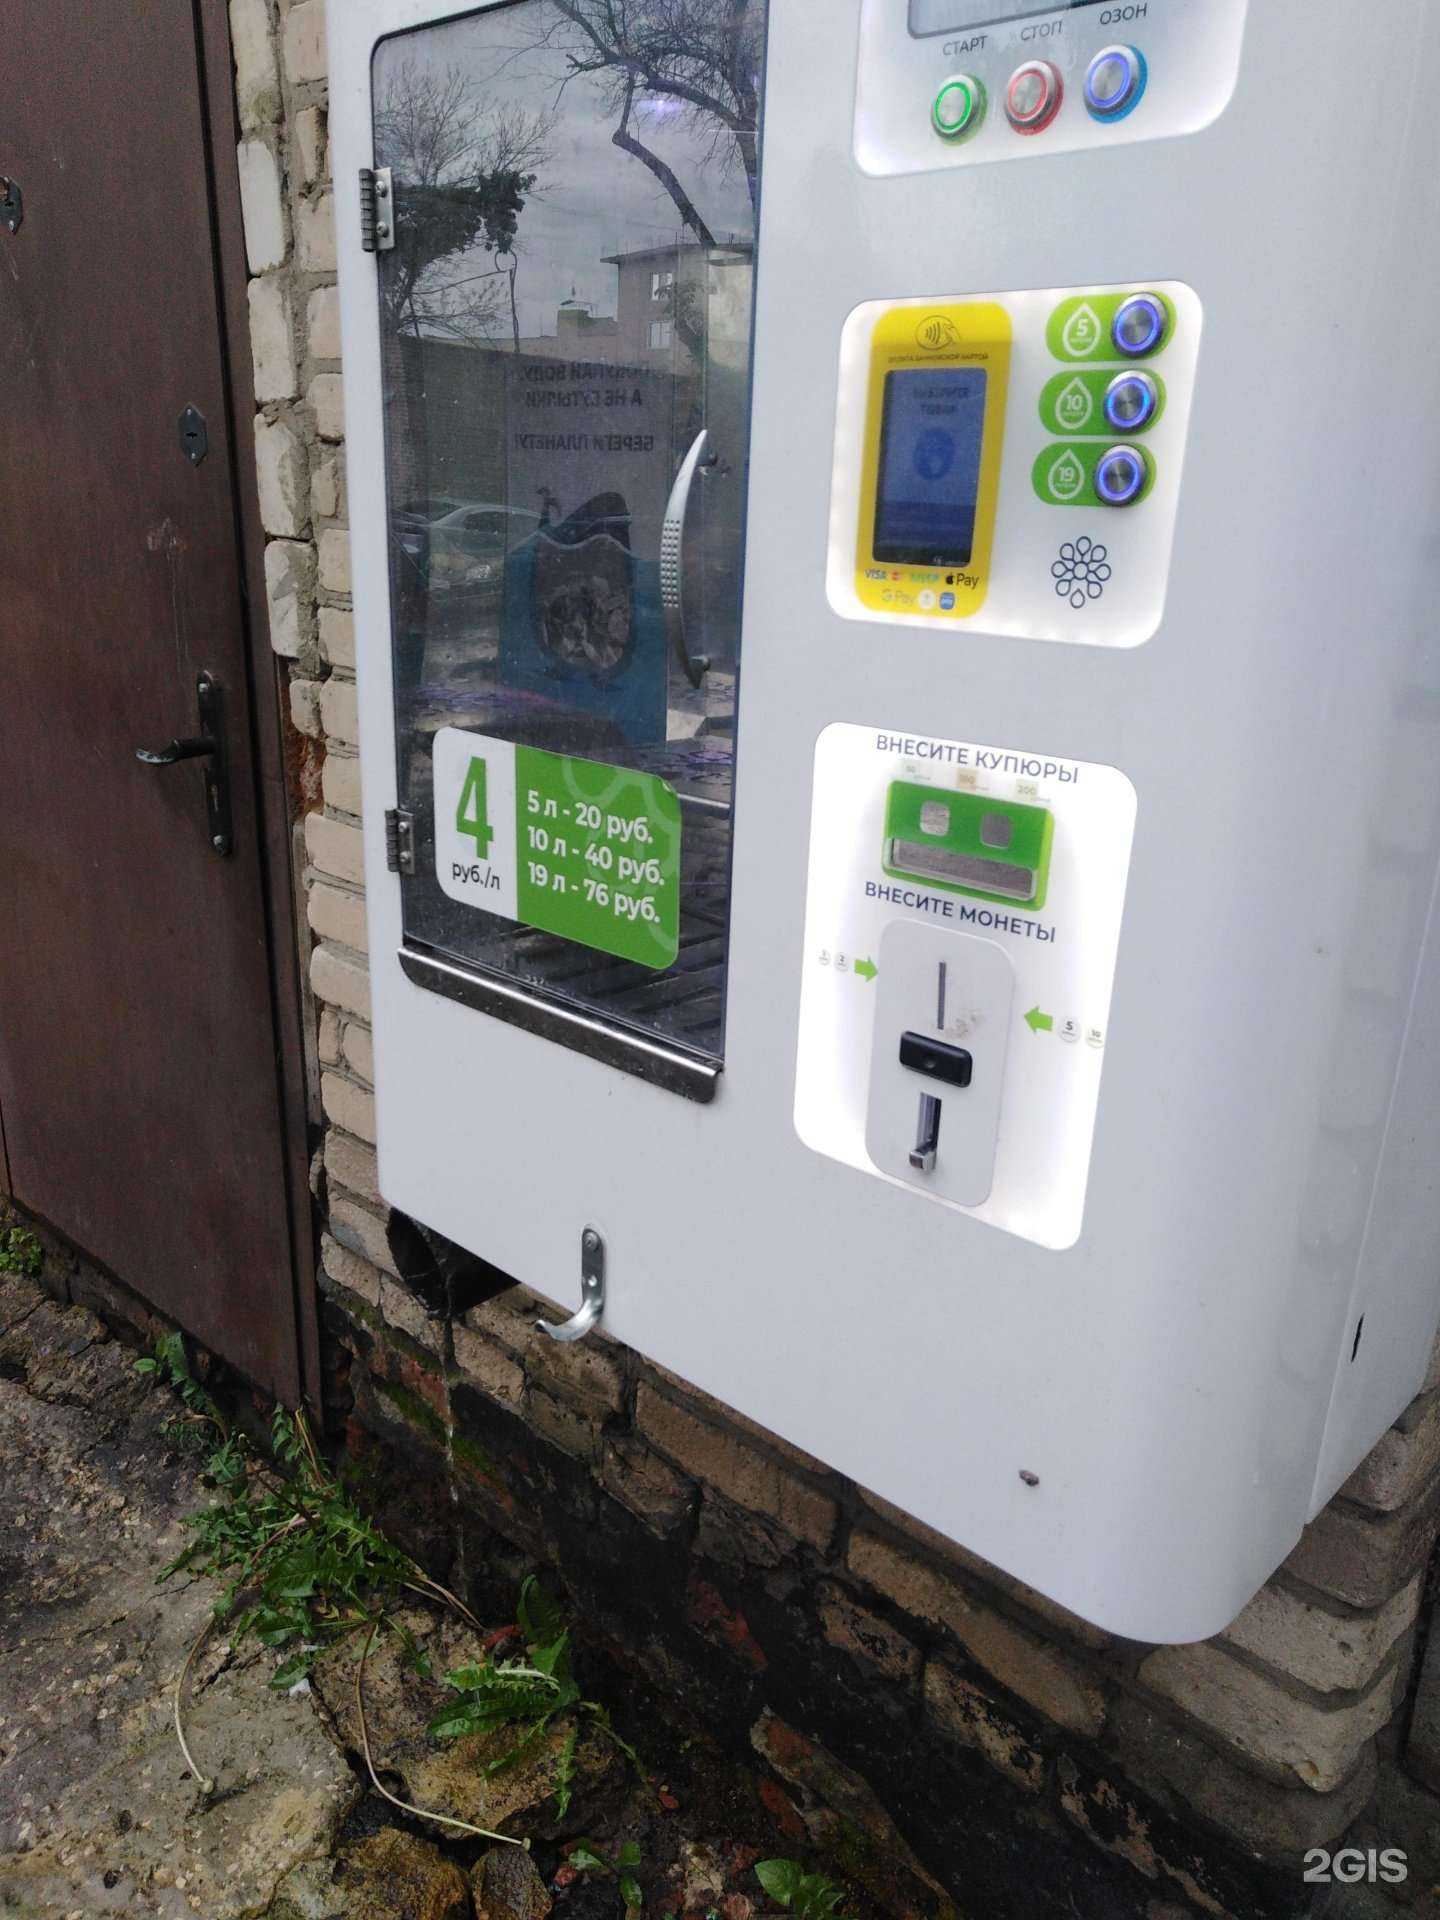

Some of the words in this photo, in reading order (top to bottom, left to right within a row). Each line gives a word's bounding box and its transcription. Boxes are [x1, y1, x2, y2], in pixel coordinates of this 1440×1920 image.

[1099, 3, 1148, 26] ОЗОН
[1020, 20, 1064, 42] СТОП
[943, 35, 988, 57] СТАРТ
[1076, 318, 1088, 337] 5
[1067, 394, 1083, 410] 10
[1059, 466, 1075, 482] 19
[956, 572, 980, 590] Pay
[876, 734, 969, 765] ВНЕСИТЕ
[975, 751, 1079, 784] КУПЮРЫ
[456, 756, 494, 860] 4
[527, 789, 540, 813] 5
[543, 798, 557, 818] л
[575, 802, 601, 829] 20
[607, 813, 654, 844] руб.
[527, 825, 548, 851] 10
[552, 836, 567, 857] л
[585, 843, 613, 870] 40
[618, 853, 665, 886] руб.
[451, 861, 501, 891] руб./л
[527, 861, 548, 887] 19
[552, 873, 566, 893] л
[583, 879, 609, 906] 76
[614, 890, 661, 923] руб.
[865, 881, 954, 918] ВНЕСИТЕ
[960, 905, 1056, 943] МОНЕТЫ
